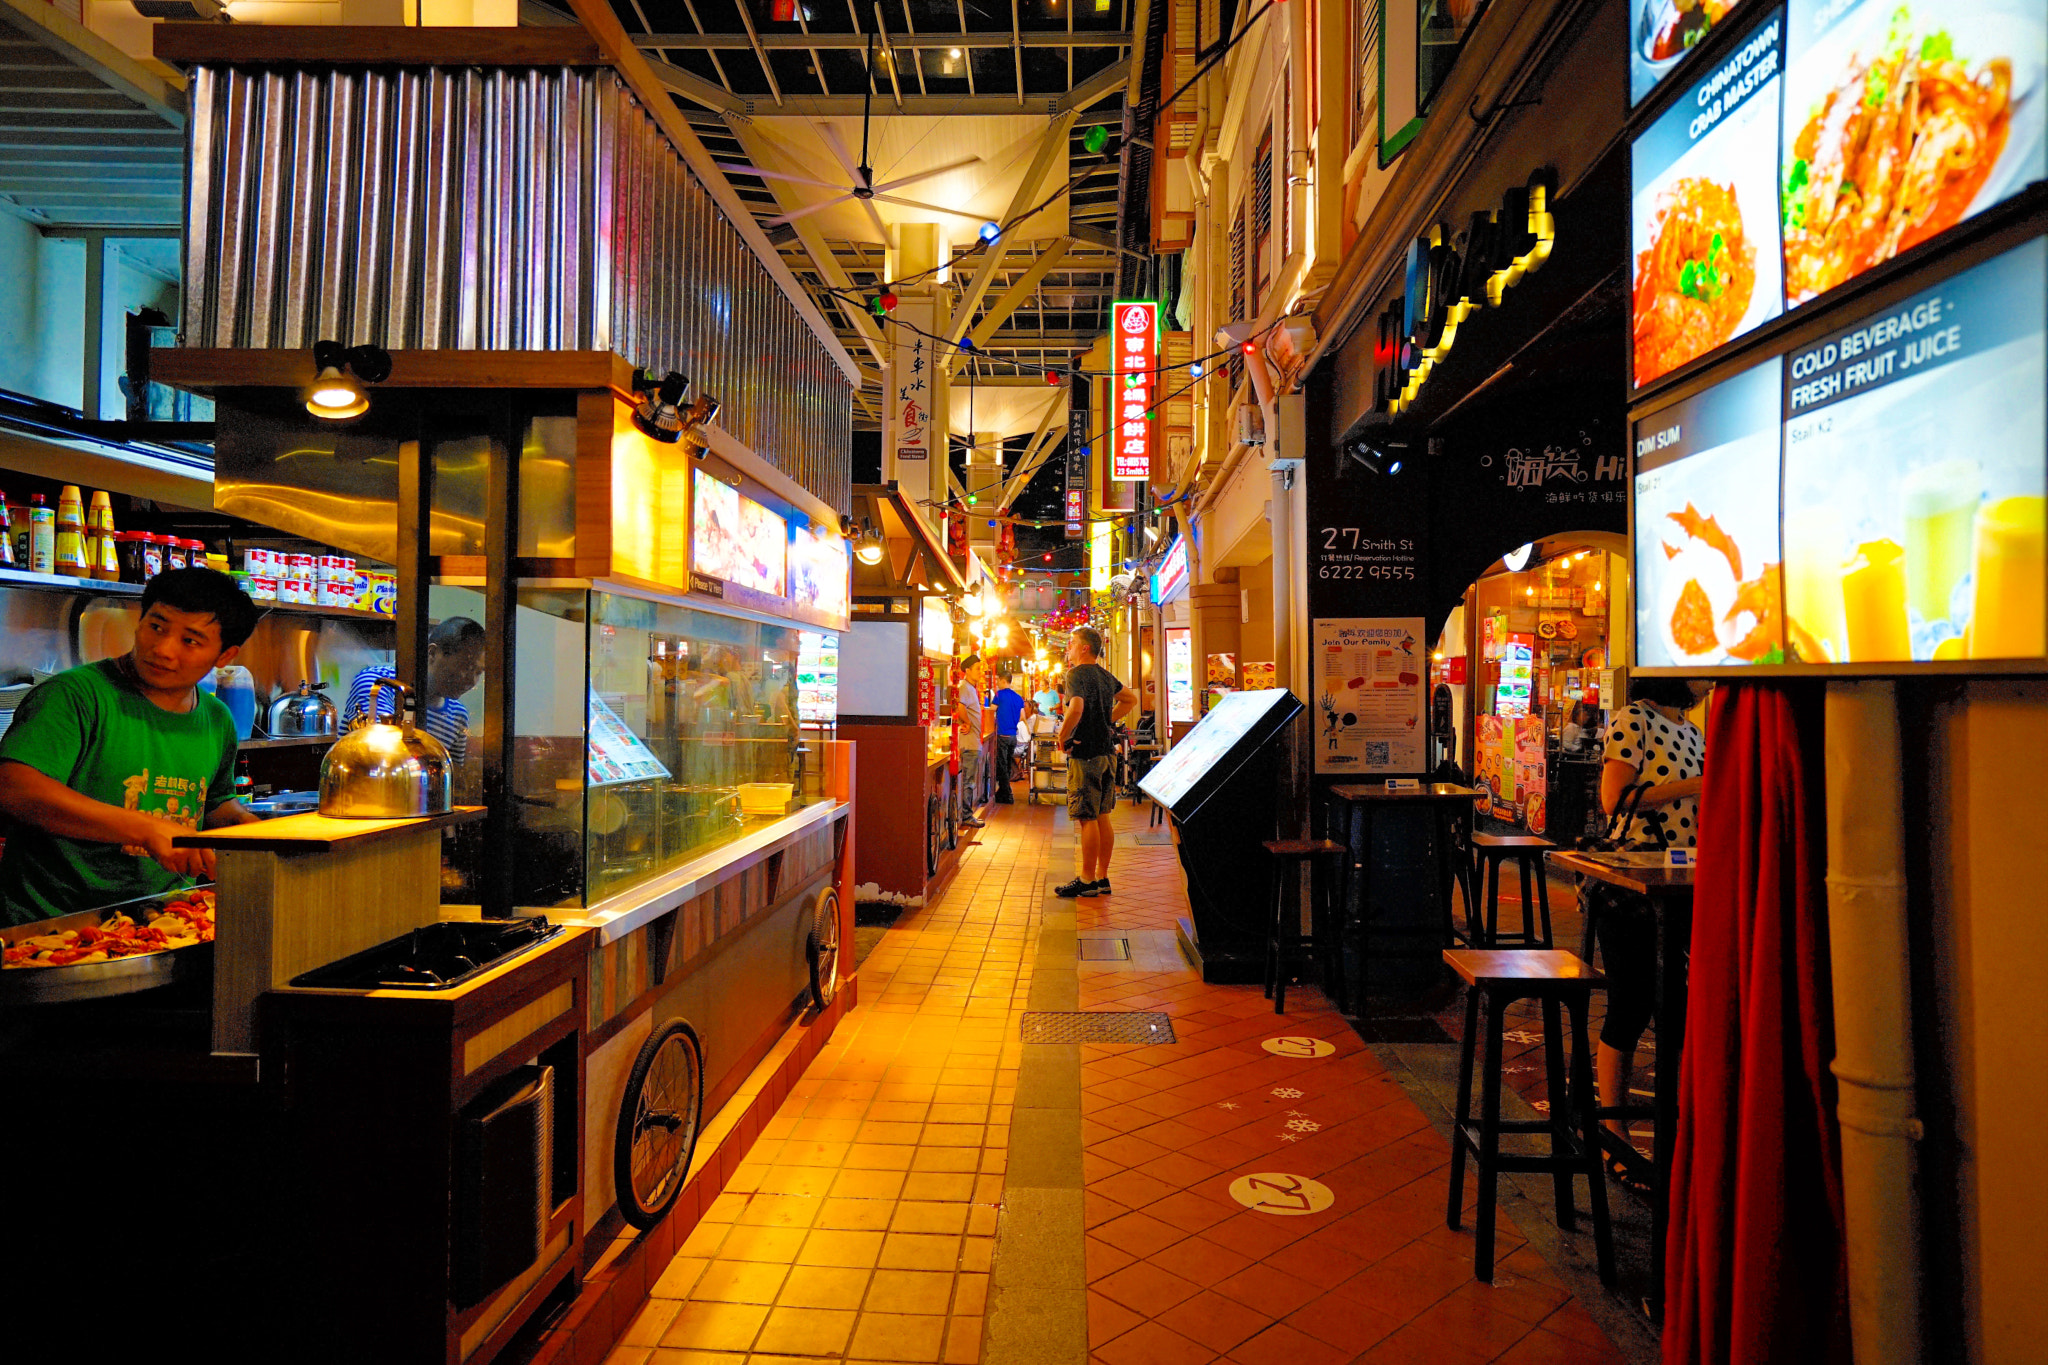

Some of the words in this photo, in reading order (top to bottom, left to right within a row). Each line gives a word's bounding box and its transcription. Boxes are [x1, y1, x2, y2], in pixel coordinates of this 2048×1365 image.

[1698, 19, 1780, 106] CHINATOWN
[1689, 100, 1722, 139] CRAB
[1723, 49, 1778, 111] MASTER
[1791, 371, 1841, 410] FRESH
[1844, 349, 1898, 390] FRUIT
[1899, 324, 1961, 370] JUICE
[1792, 343, 1838, 380] COLD
[1840, 297, 1942, 361] BEVERAGE
[1636, 435, 1656, 457] DIM
[1657, 424, 1681, 450] SUM
[1320, 527, 1360, 550] 27
[1362, 539, 1396, 550] Smith
[1400, 540, 1414, 550] St
[1319, 565, 1364, 579] 6222
[1369, 565, 1415, 580] 9555
[1361, 638, 1391, 647] Family
